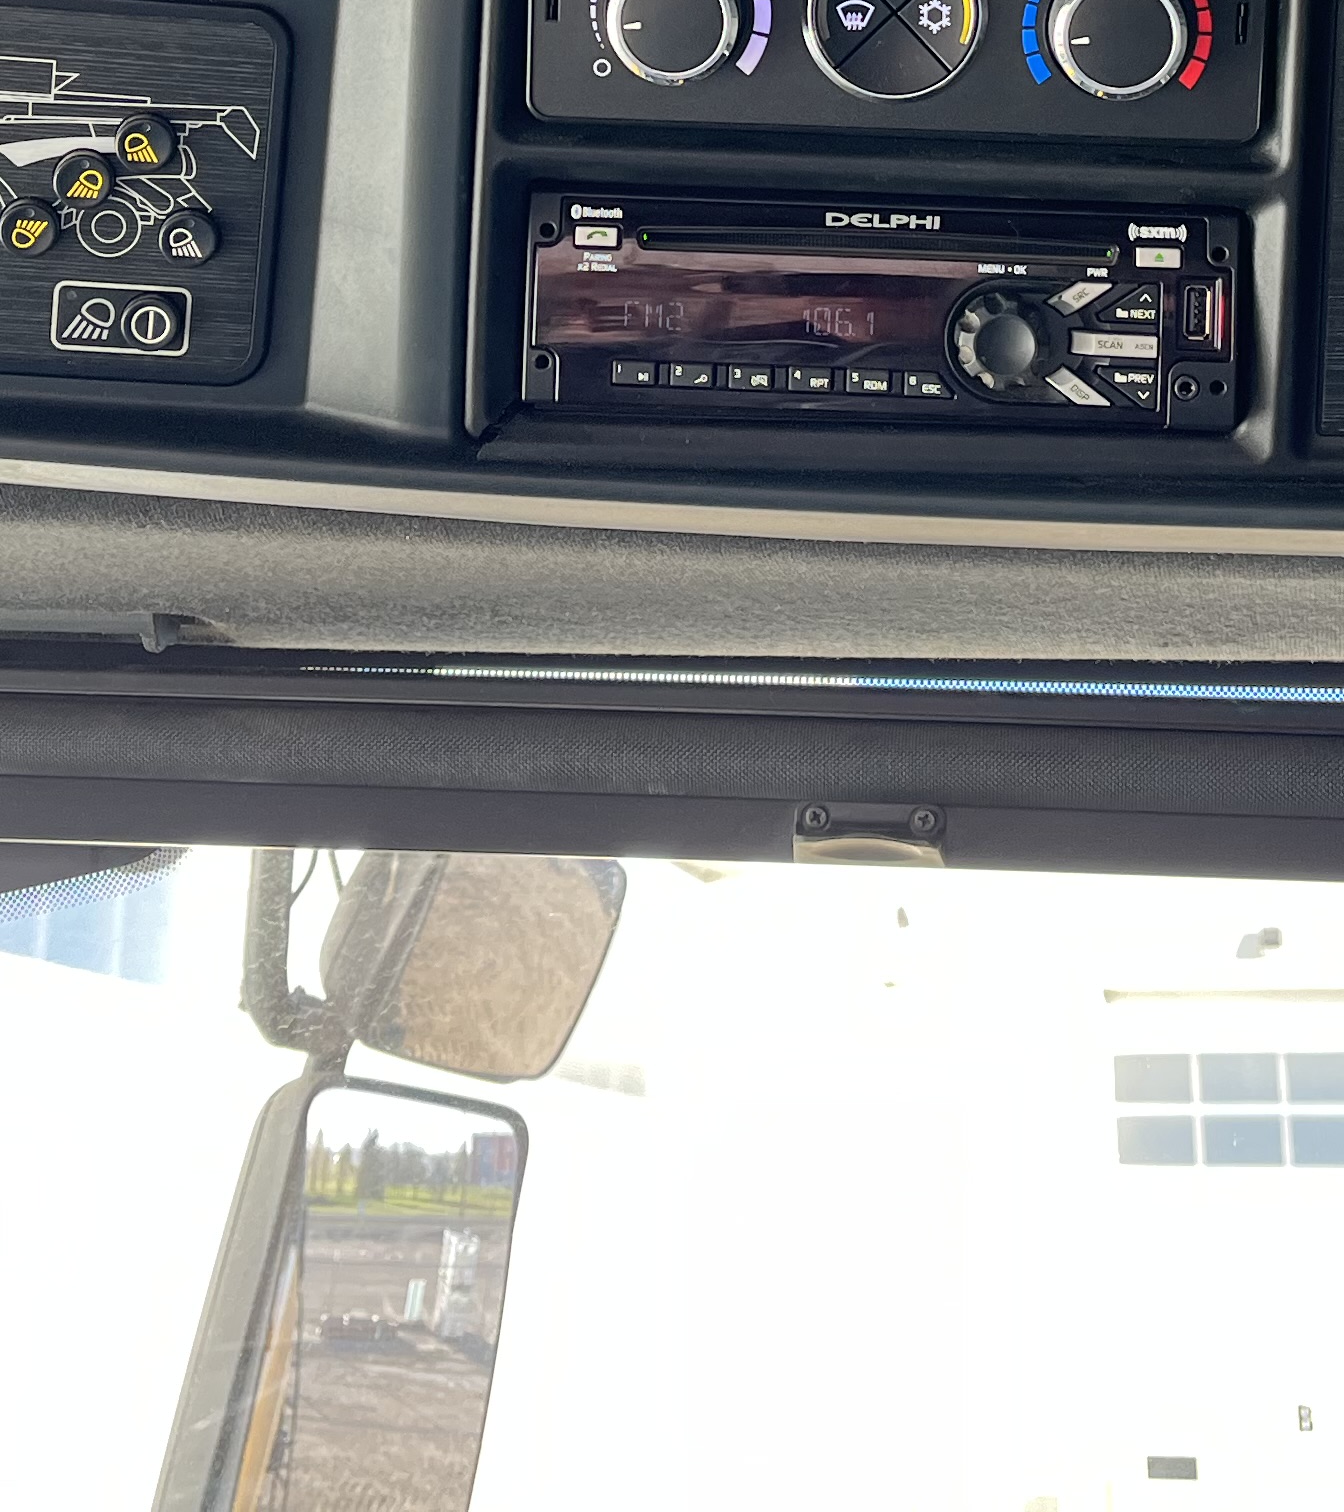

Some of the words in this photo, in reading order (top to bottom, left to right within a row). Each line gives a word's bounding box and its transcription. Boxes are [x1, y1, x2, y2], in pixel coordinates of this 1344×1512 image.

[582, 206, 624, 219] Bluetooth
[825, 211, 941, 230] DELPHI
[977, 263, 1005, 274] MENU
[1013, 264, 1027, 276] OK
[1086, 267, 1109, 278] PWR
[1072, 287, 1091, 304] SRC
[1129, 308, 1156, 320] NEXT
[1097, 339, 1124, 350] SCAN
[617, 363, 622, 374] 1
[674, 365, 683, 376] 2
[733, 368, 742, 379] 3
[793, 370, 802, 380] 4
[851, 372, 860, 383] 5
[908, 375, 917, 386] 6
[1127, 373, 1155, 384] PREV
[809, 377, 830, 389] RPT
[921, 383, 942, 396] ESC
[1070, 383, 1090, 401] DISP
